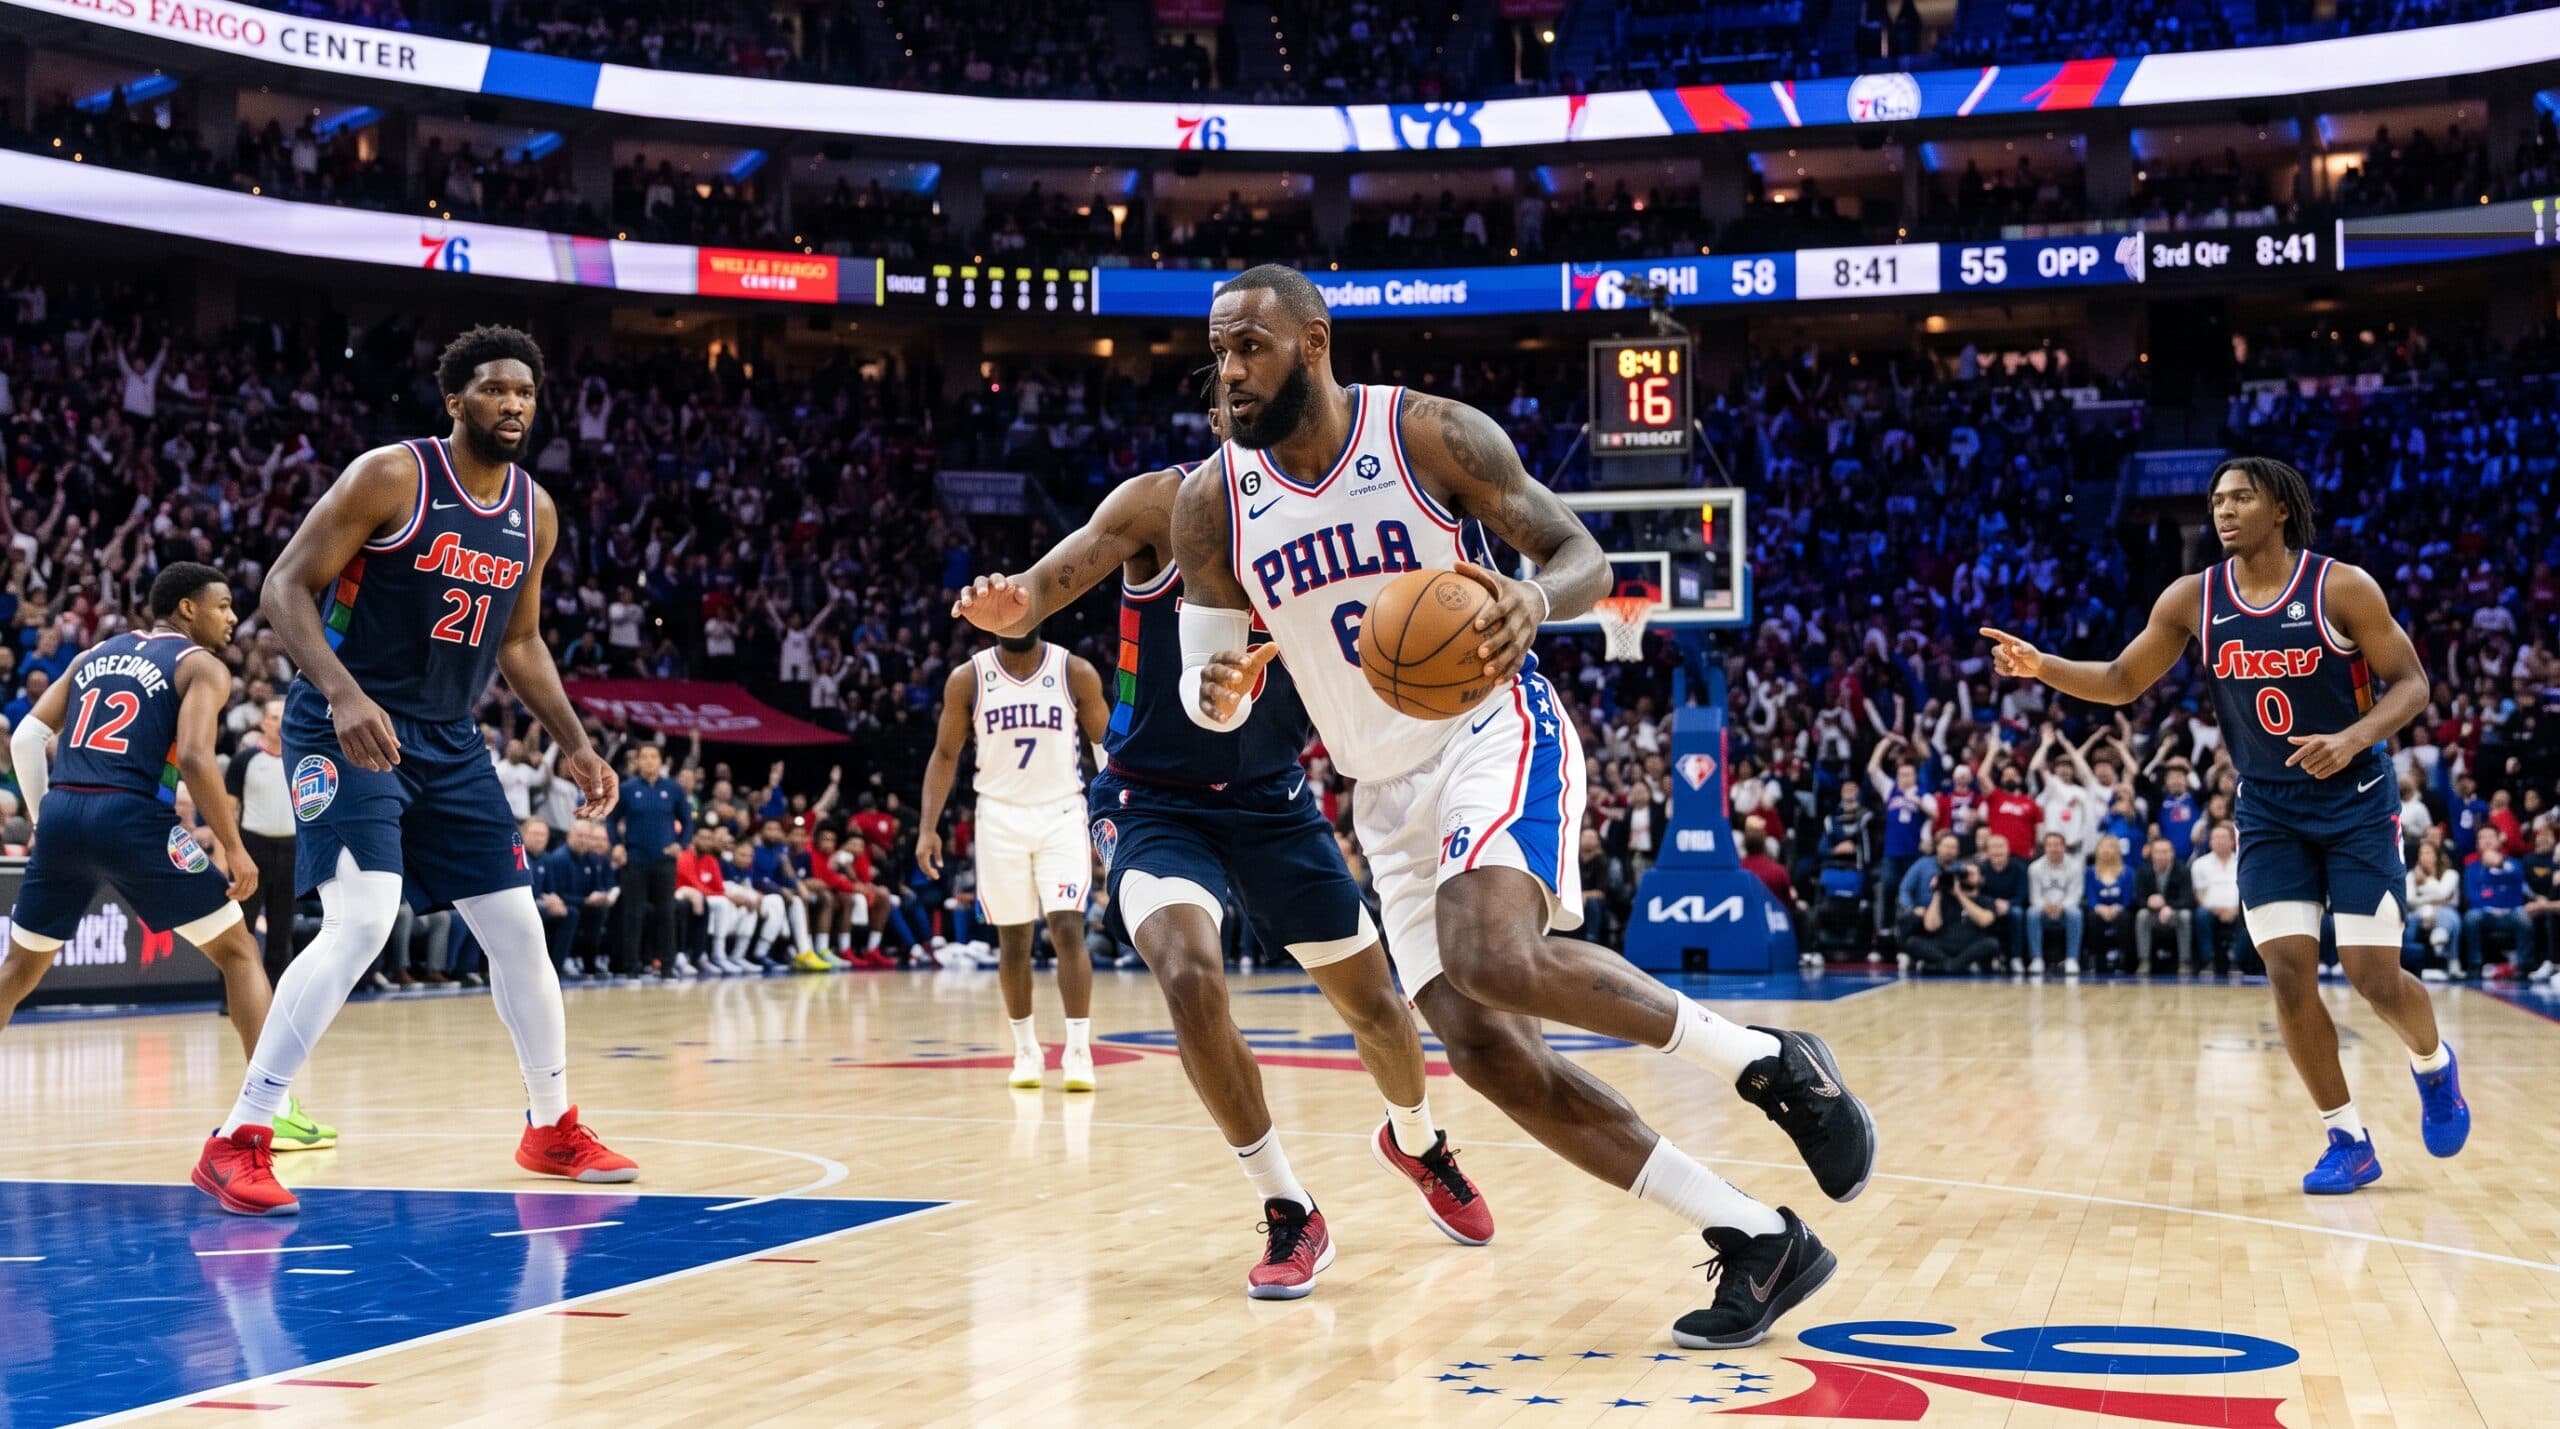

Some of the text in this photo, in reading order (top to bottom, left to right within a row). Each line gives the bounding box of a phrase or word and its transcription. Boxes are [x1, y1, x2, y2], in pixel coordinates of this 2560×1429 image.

[149, 0, 266, 46] FARGO
[280, 28, 417, 71] CENTER
[1176, 115, 1227, 150] 76
[419, 234, 471, 273] 76
[2152, 232, 2316, 268] 3rd Qtr 8:41
[1731, 258, 1777, 296] 58
[1833, 256, 1900, 288] 8:41
[1959, 248, 2007, 286] 55
[2038, 247, 2099, 278] OPP
[1617, 349, 1680, 378] 8:41
[1628, 377, 1672, 425] 16
[1349, 479, 1397, 497] crypto.com
[414, 531, 524, 589] Sixers
[1252, 520, 1422, 610] PHILA
[431, 588, 492, 647] 21
[74, 655, 169, 699] EDGECOMBE
[2212, 639, 2323, 680] Sixers
[69, 688, 140, 755] 12
[984, 703, 1062, 735] PHILA
[2255, 686, 2294, 736] 0
[1014, 737, 1037, 770] 7
[1440, 825, 1471, 867] 76
[1057, 883, 1077, 899] 76
